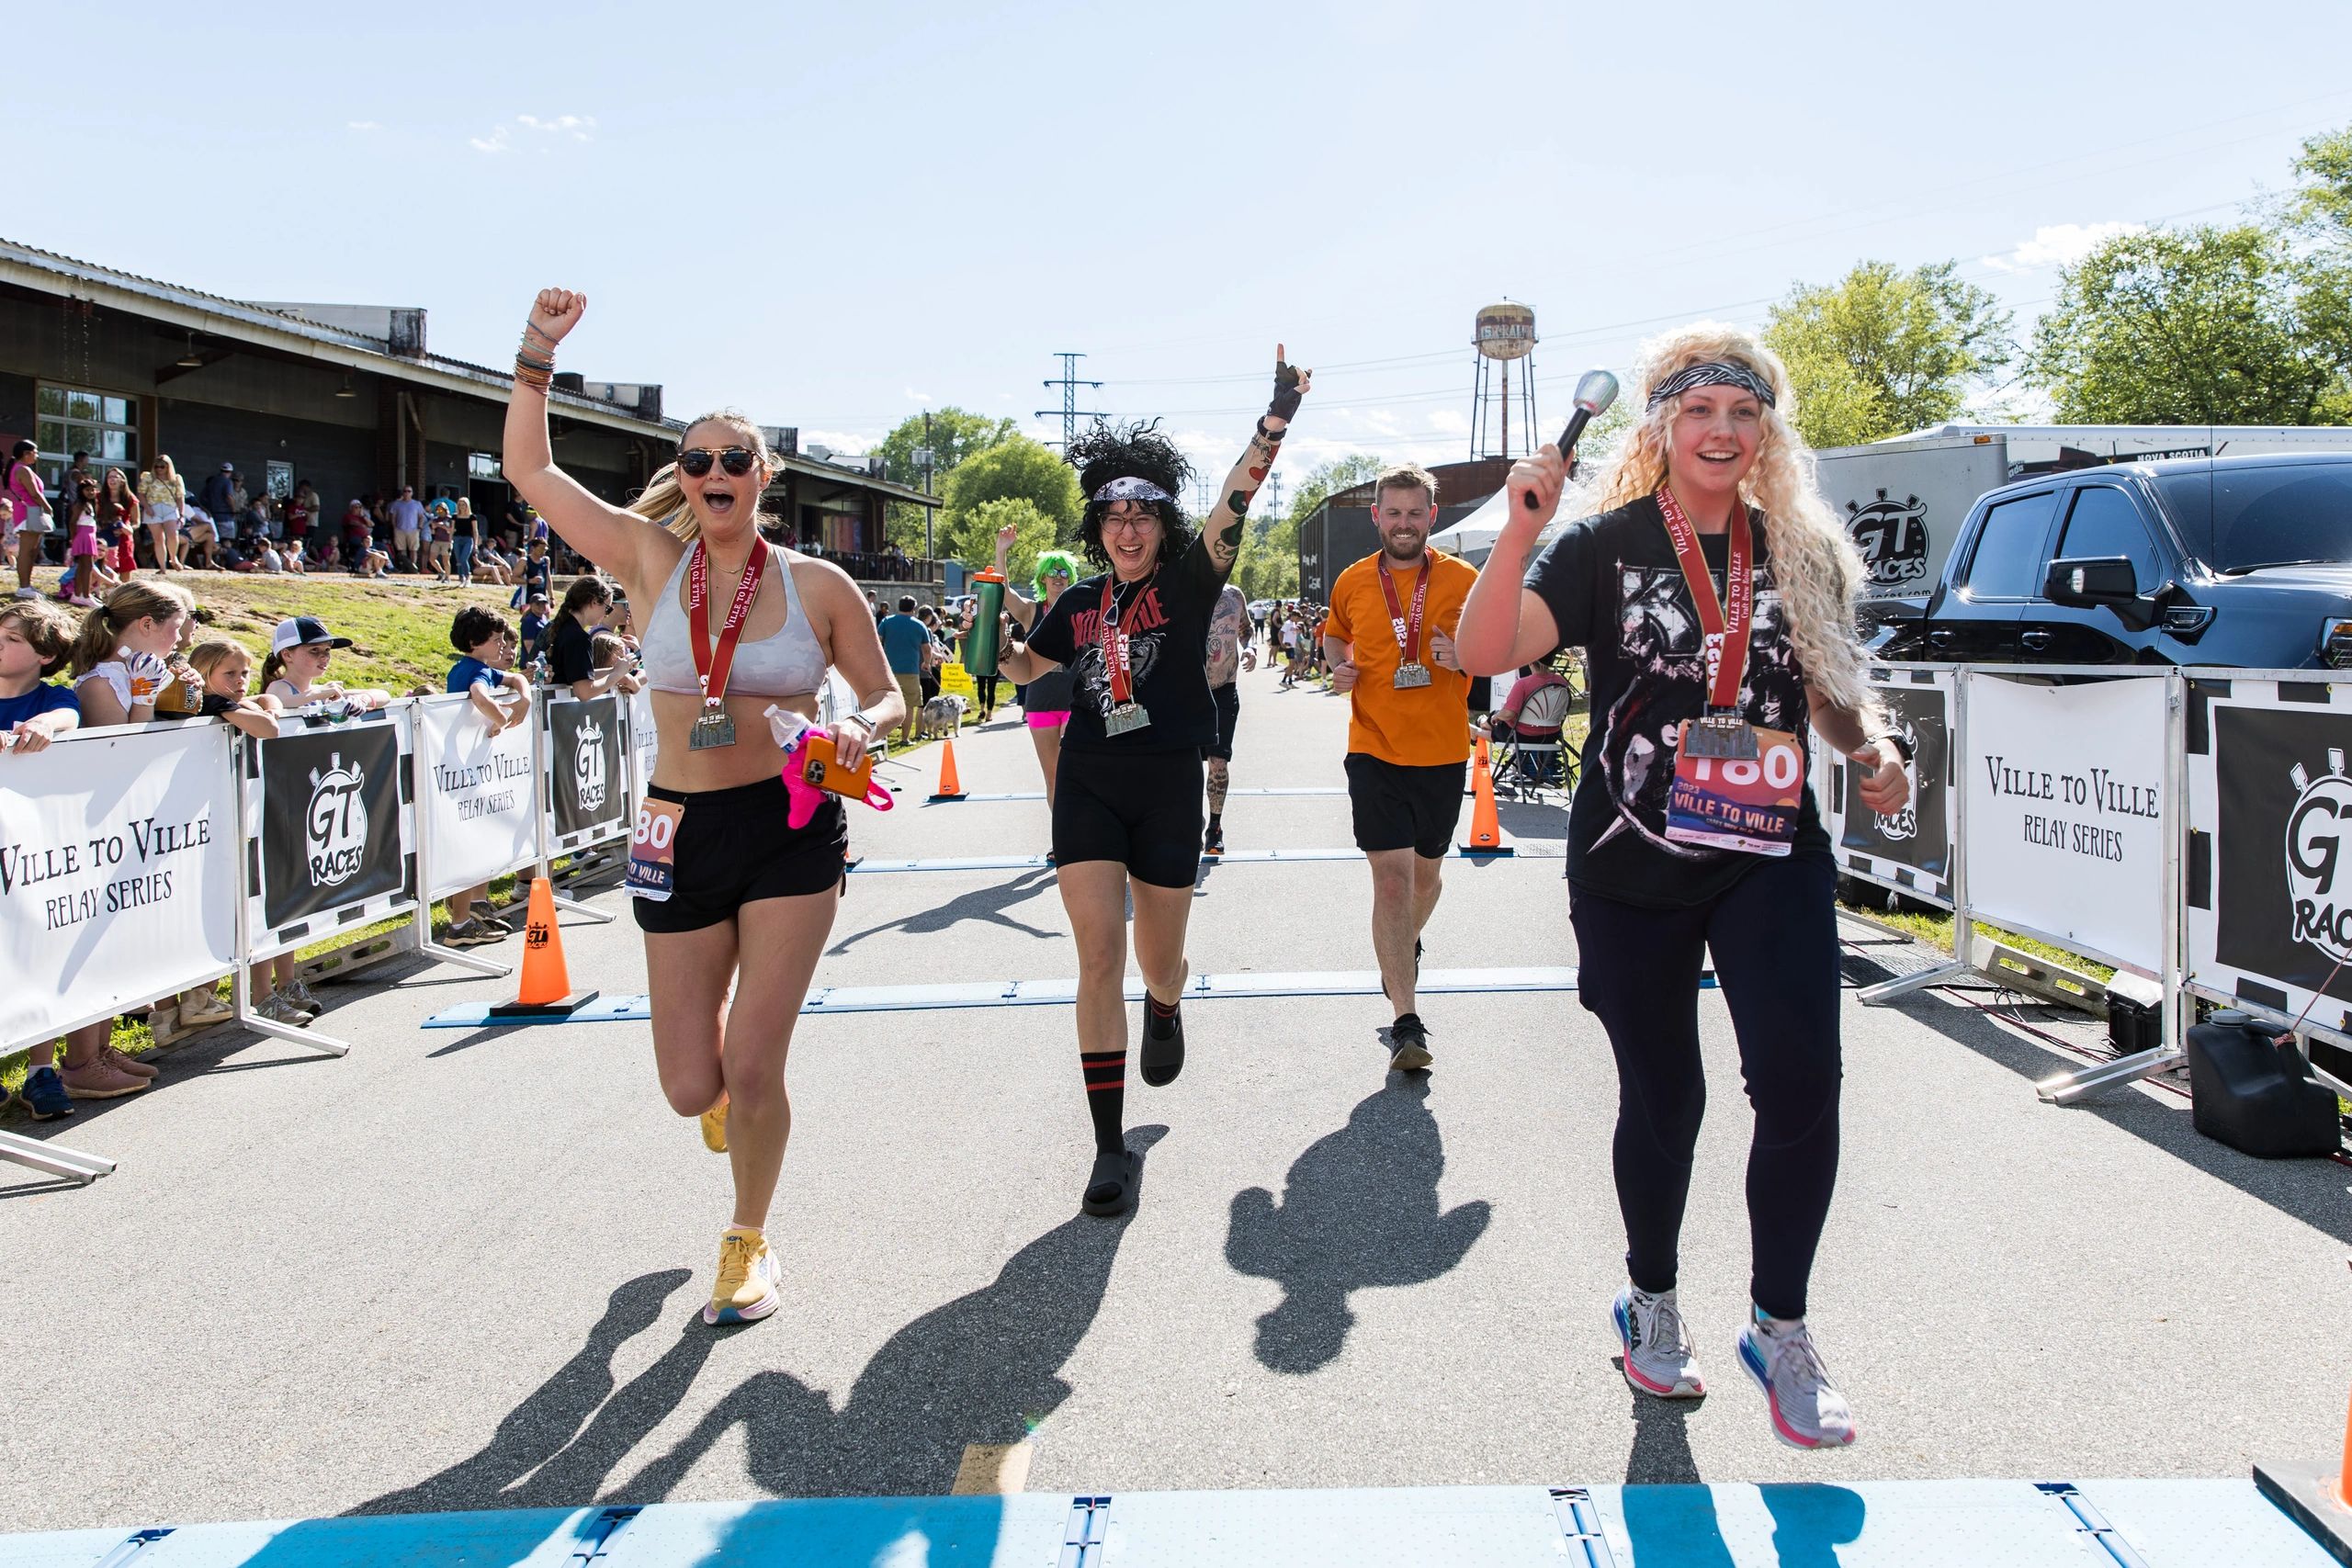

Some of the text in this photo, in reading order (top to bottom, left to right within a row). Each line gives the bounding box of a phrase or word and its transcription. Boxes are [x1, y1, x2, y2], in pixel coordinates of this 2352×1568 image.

[2137, 449, 2205, 461] NOVA SCOTIA
[1845, 502, 1927, 559] GT
[692, 570, 699, 581] TO
[1871, 558, 1926, 581] ACES
[691, 582, 701, 610] VILLE
[724, 566, 755, 629] VILLE TO VILLE
[1726, 551, 1741, 635] VILLE TO VILLE
[434, 753, 530, 796] VILLE TO VILLE
[576, 734, 603, 784] GT
[458, 790, 515, 822] RELAY SERIES
[580, 784, 604, 807] RACES
[1678, 782, 1700, 794] 2023
[1985, 755, 2159, 819] VILLE TO VILLE
[309, 773, 364, 850] GT
[1674, 792, 1784, 834] VILLE TO VILLE
[0, 818, 210, 896] VILLE TO VILLE
[2024, 814, 2122, 863] RELAY SERIES
[311, 845, 362, 884] RACES
[639, 864, 665, 885] VILLE
[45, 871, 173, 931] RELAY SERIES
[1628, 1303, 1642, 1352] HOKA
